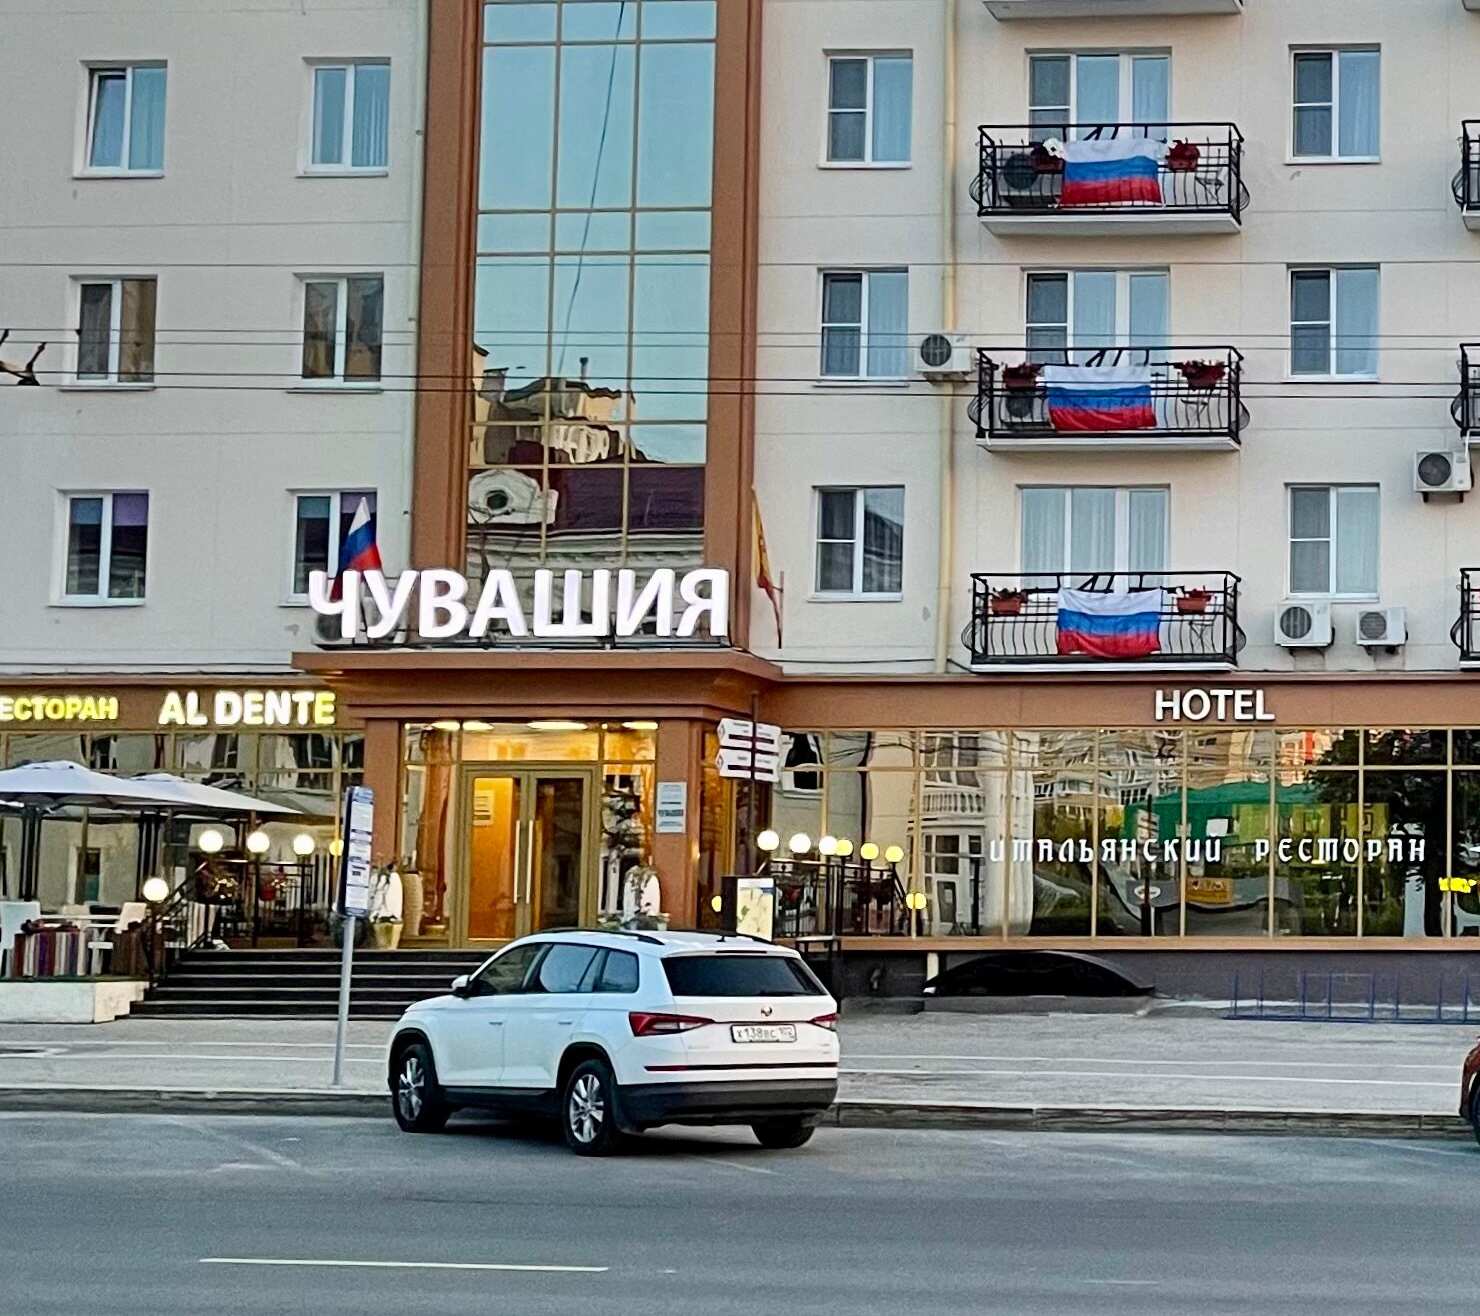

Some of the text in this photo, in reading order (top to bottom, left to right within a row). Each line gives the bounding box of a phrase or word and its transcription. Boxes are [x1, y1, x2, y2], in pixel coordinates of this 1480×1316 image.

[307, 568, 730, 639] ЧУВАШИЯ
[158, 691, 337, 726] AL DENTE
[1155, 689, 1276, 721] HOTEL
